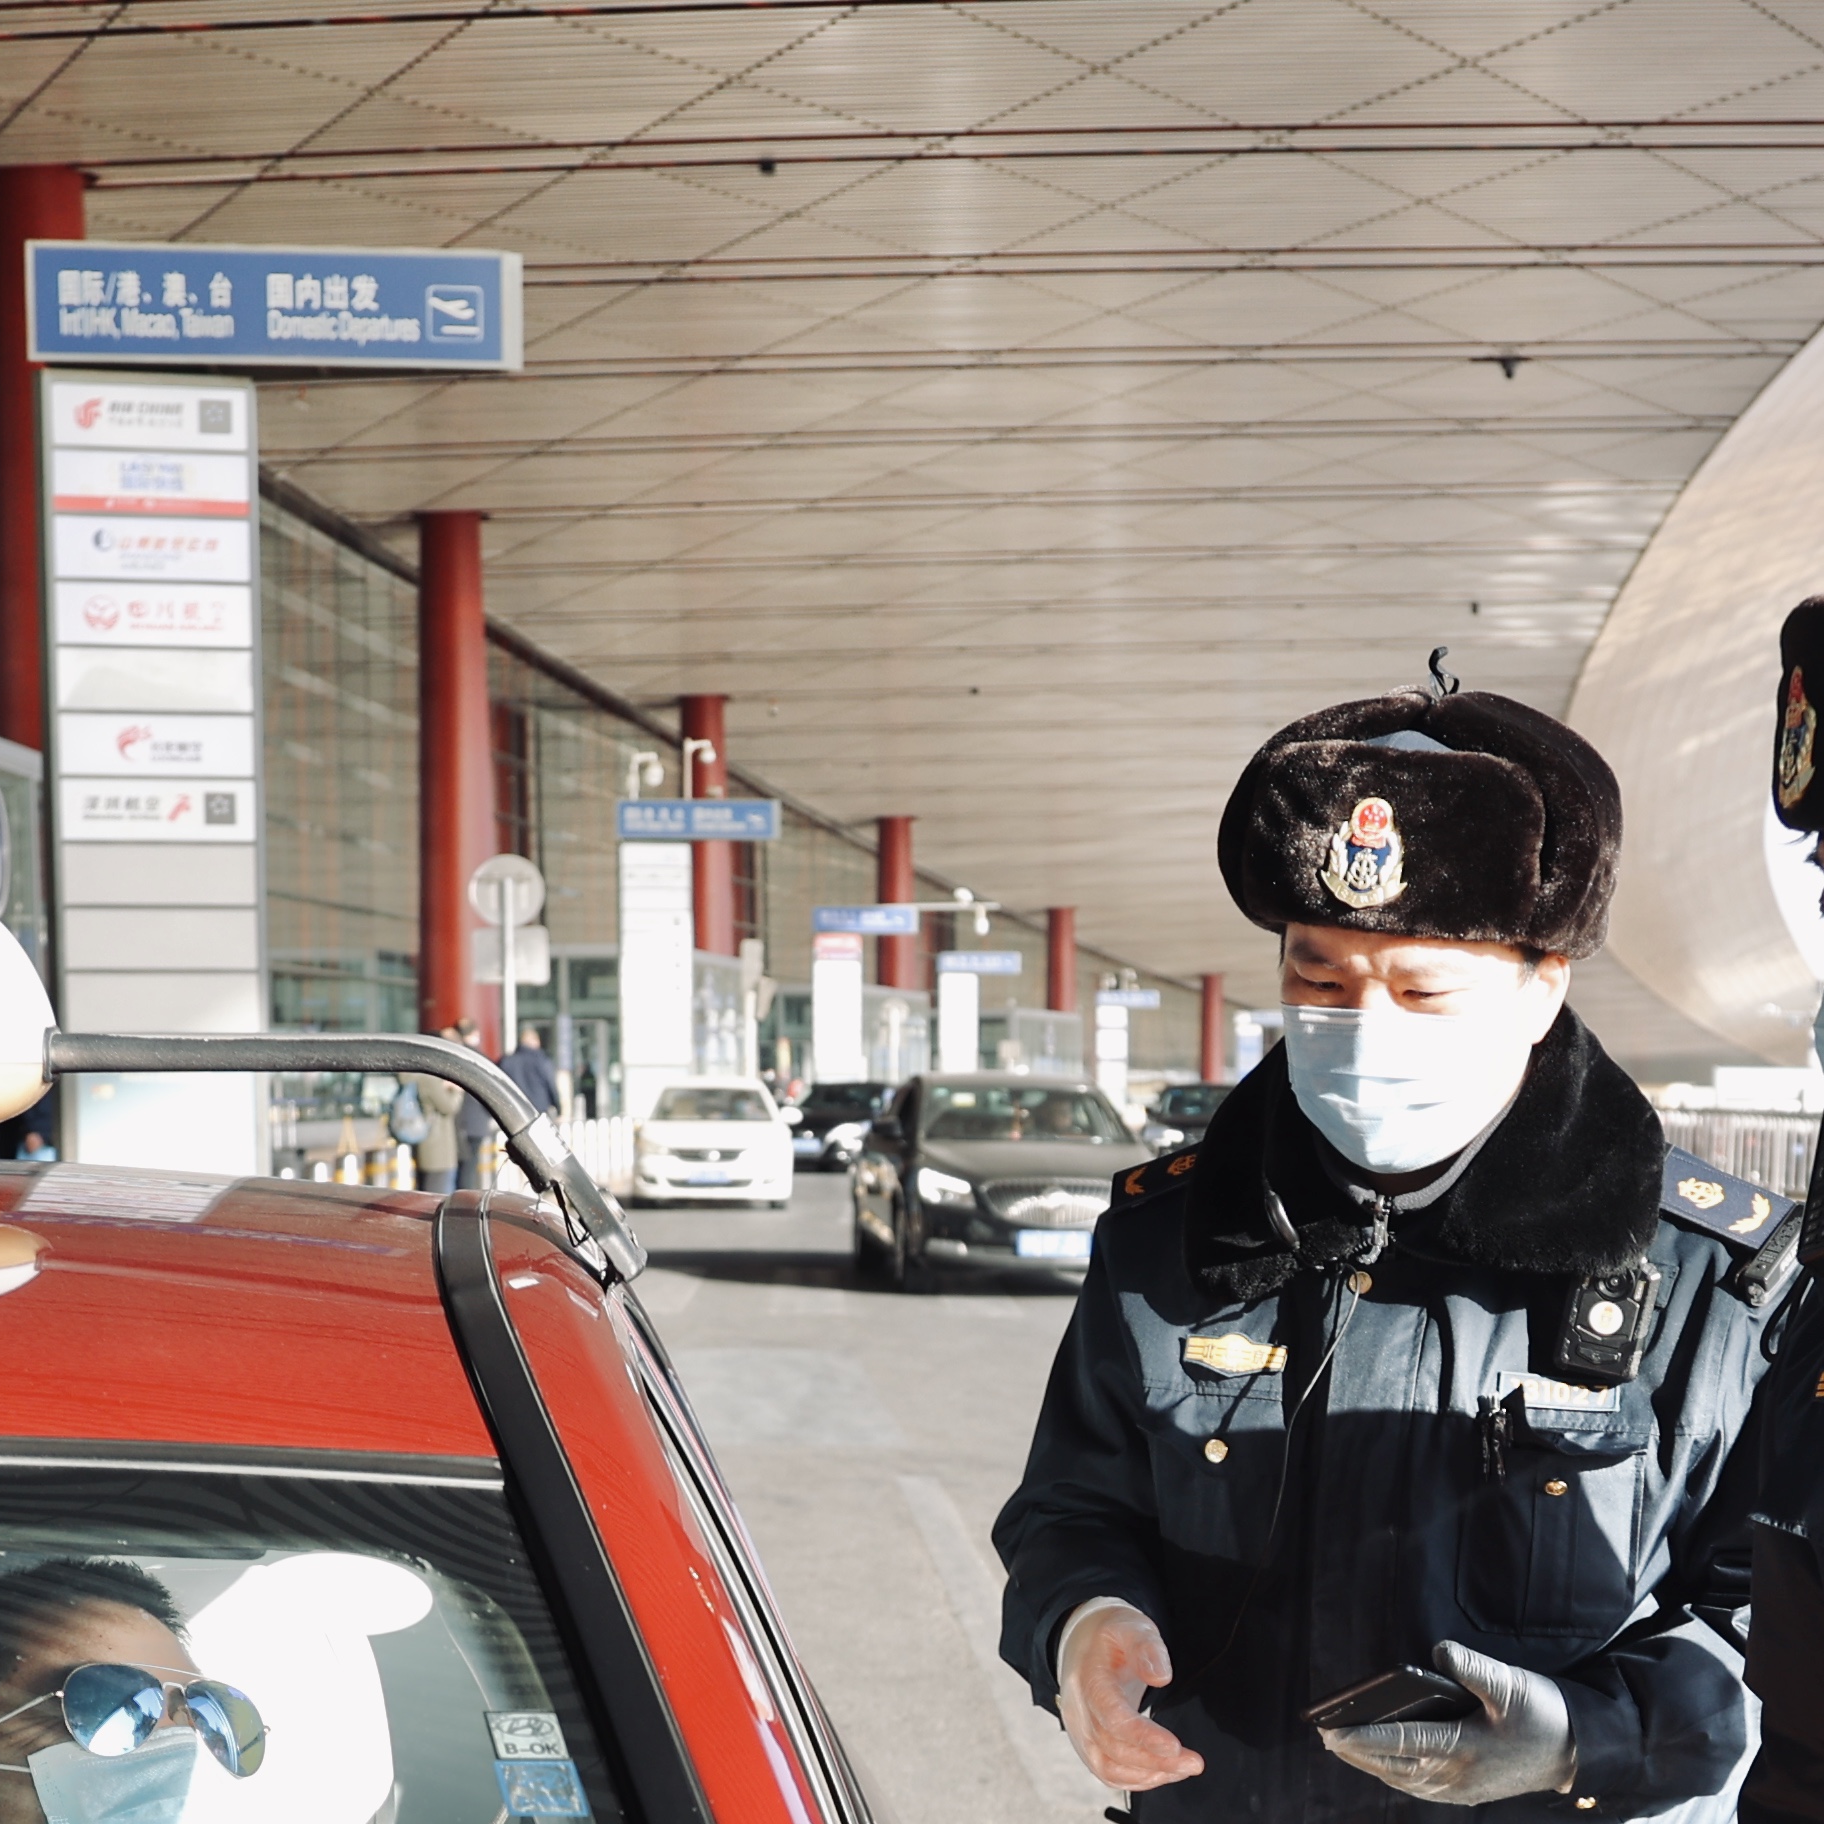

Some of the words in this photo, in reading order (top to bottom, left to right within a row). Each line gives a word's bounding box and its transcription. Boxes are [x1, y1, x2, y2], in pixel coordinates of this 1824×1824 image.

[265, 272, 380, 310] 国内出发
[503, 1742, 561, 1755] B-OK
